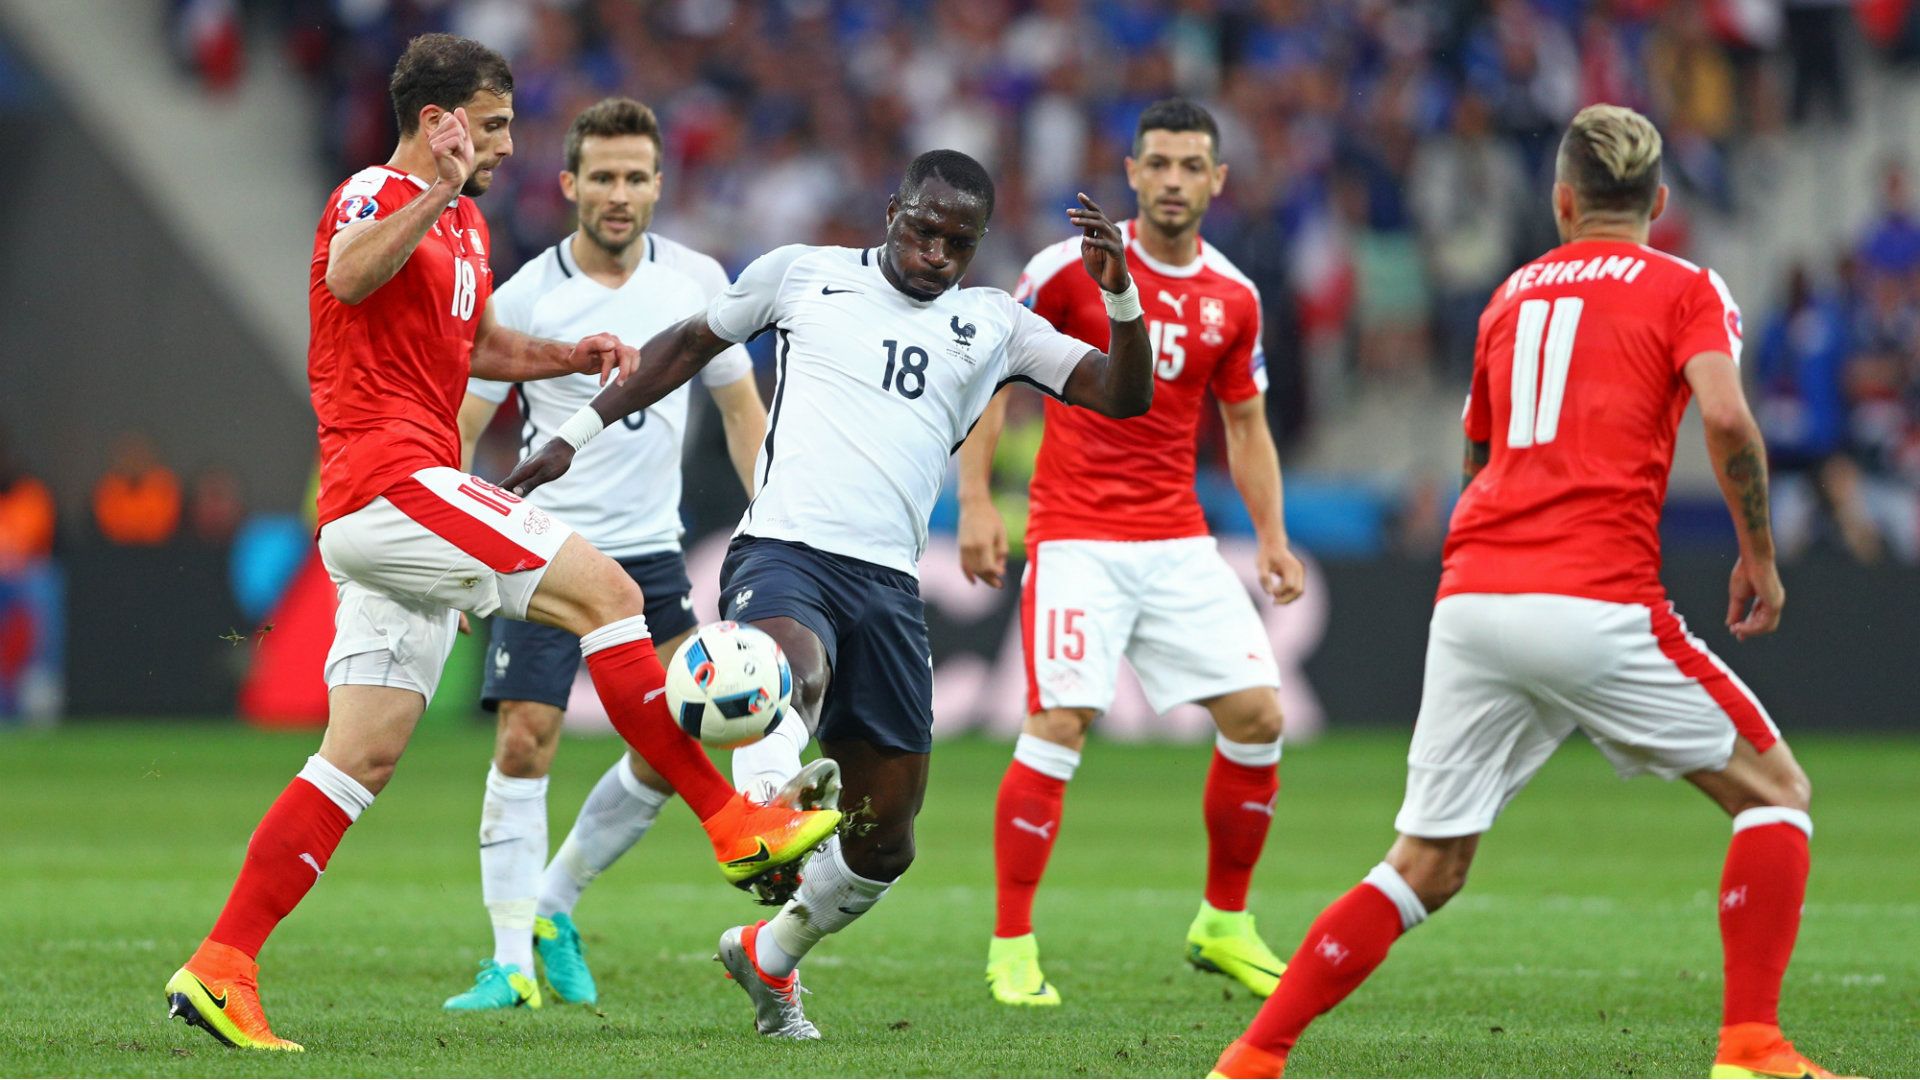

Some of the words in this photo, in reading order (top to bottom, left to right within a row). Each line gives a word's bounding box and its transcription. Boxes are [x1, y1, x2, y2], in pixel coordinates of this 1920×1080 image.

[451, 256, 477, 321] 18
[882, 339, 929, 400] 18
[1149, 320, 1189, 380] 15
[1507, 296, 1584, 448] 11
[1047, 608, 1085, 661] 15
